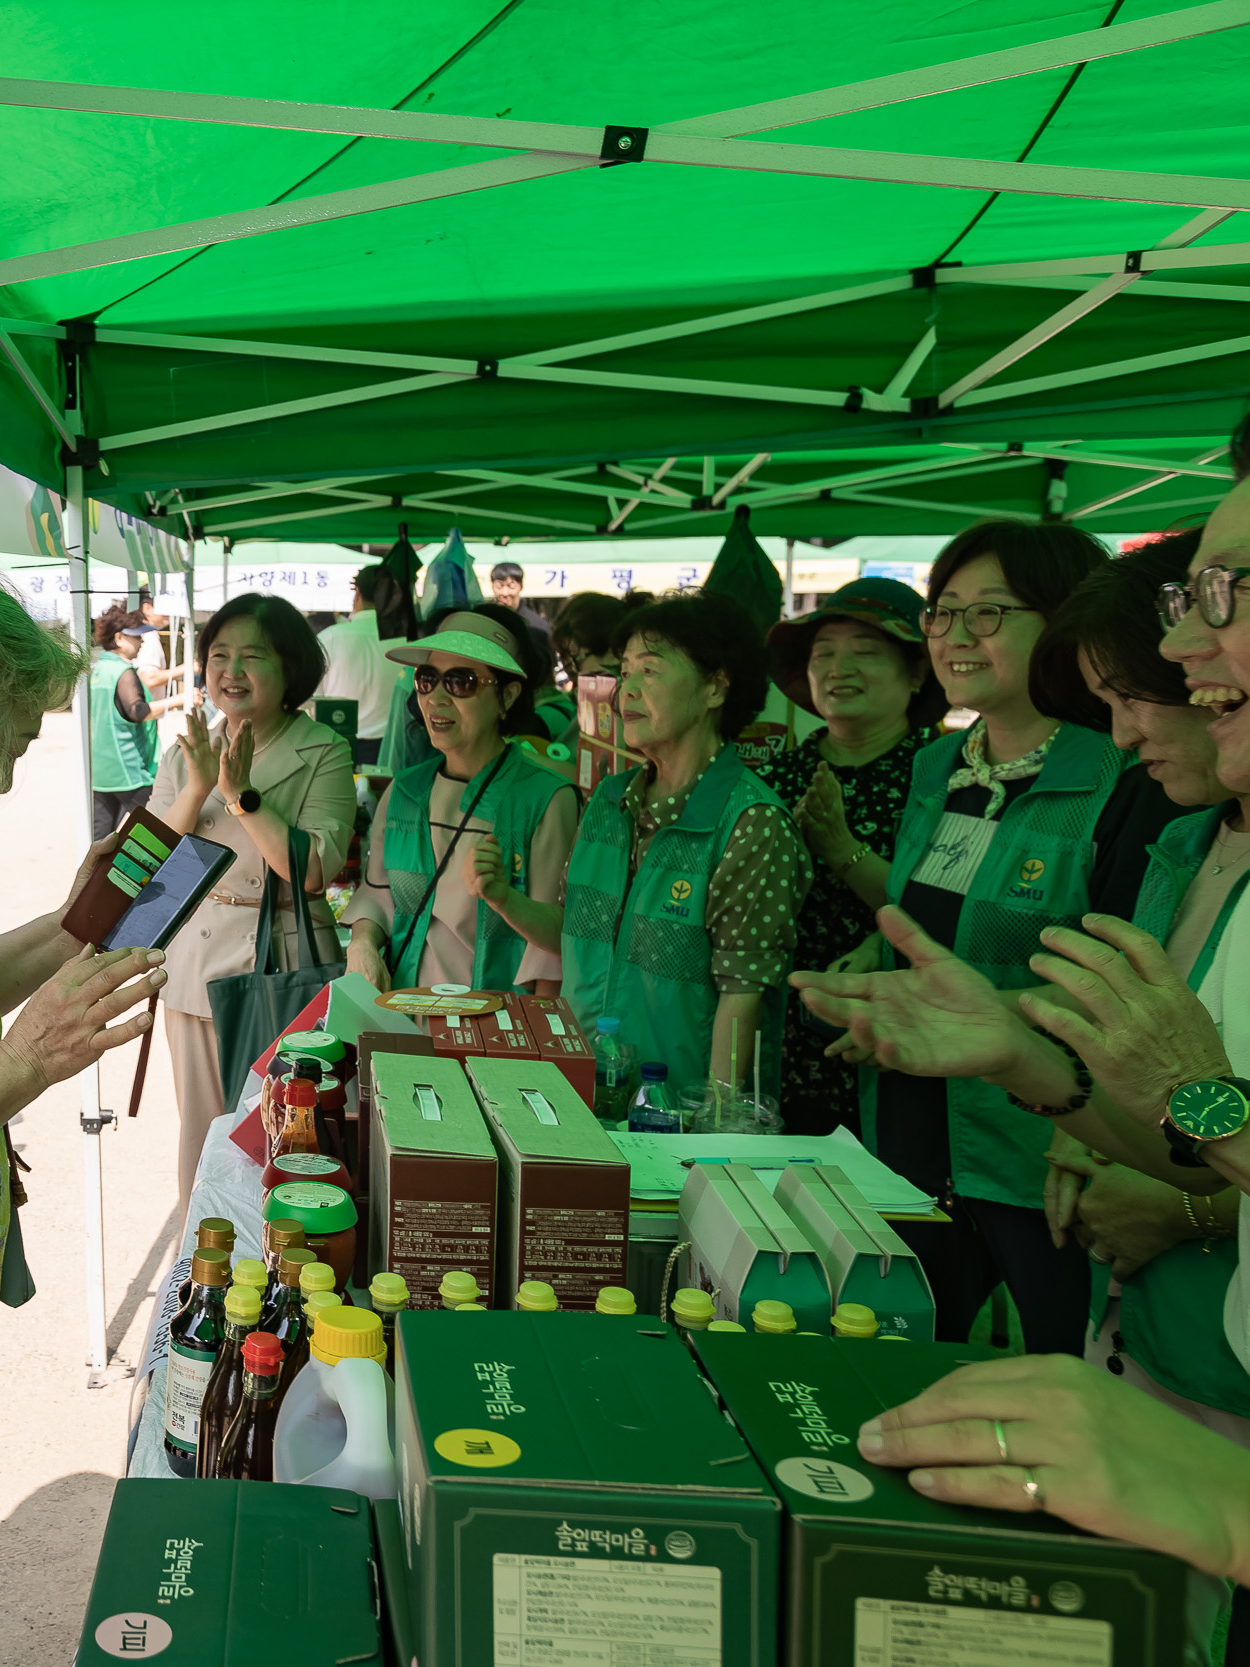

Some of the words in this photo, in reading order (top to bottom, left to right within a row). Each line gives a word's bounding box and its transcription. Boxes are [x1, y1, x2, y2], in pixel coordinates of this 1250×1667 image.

[1007, 884, 1044, 902] SMU
[659, 902, 691, 919] SMU
[474, 1361, 526, 1416] 솔잎떡마을
[768, 1380, 850, 1446] 솔잎떡마을
[464, 1440, 495, 1455] 깨
[802, 1463, 849, 1495] 기피
[554, 1520, 648, 1556] 솔잎떡마을
[158, 1537, 204, 1600] 솔잎떡마을
[925, 1564, 1031, 1608] 솔잎떡마을
[119, 1619, 147, 1652] 기피
